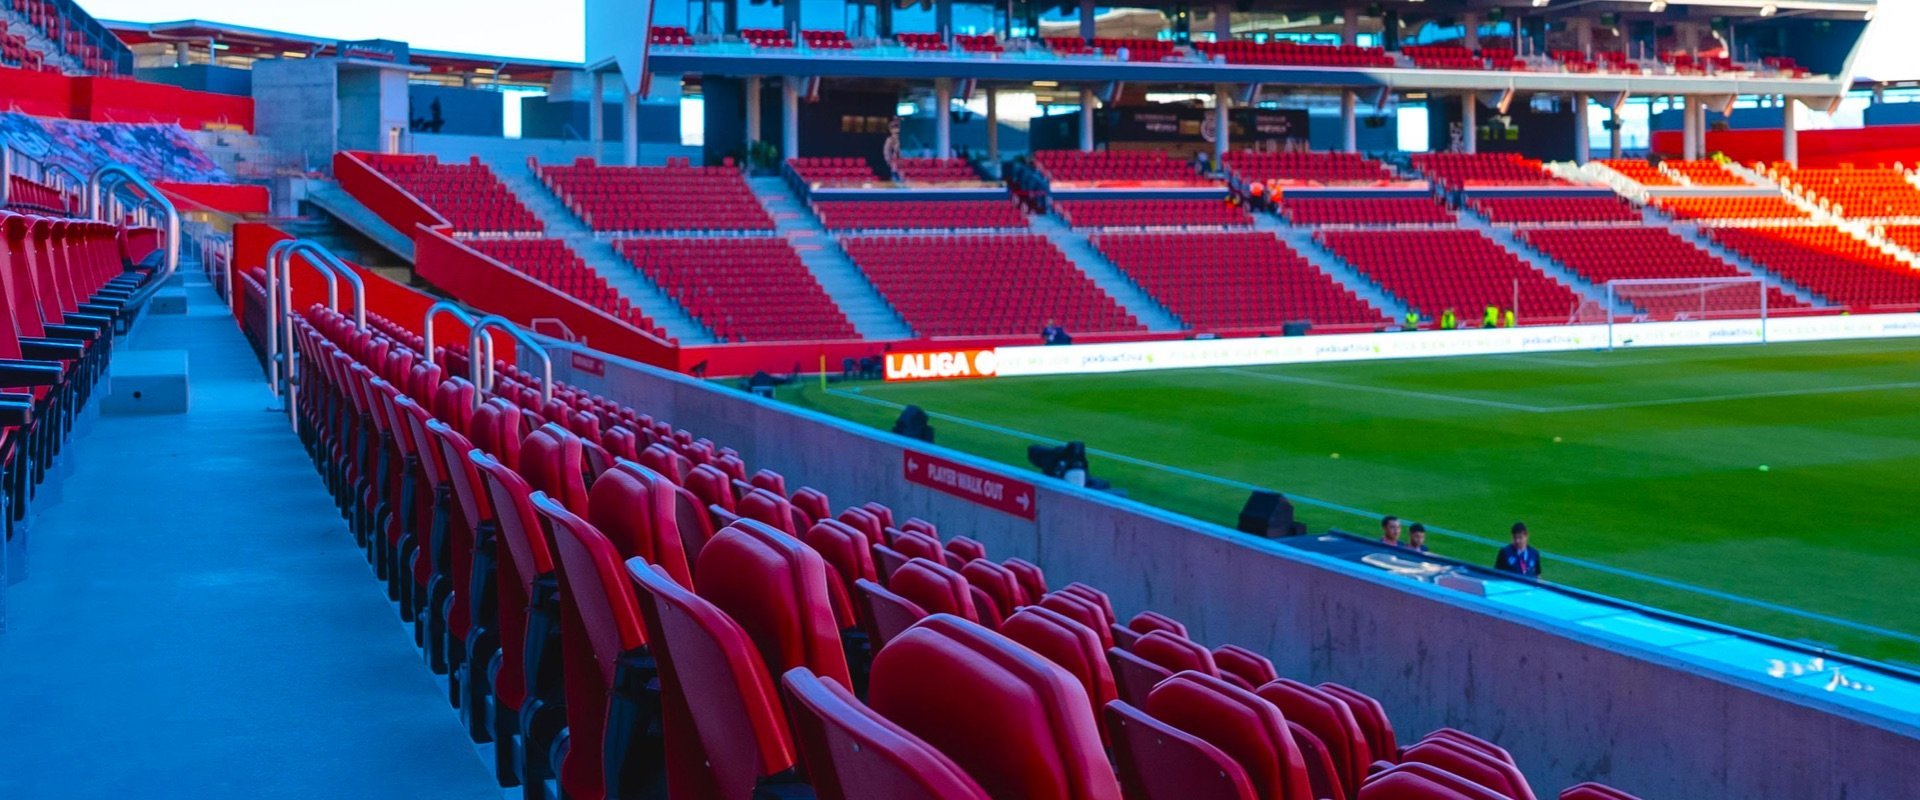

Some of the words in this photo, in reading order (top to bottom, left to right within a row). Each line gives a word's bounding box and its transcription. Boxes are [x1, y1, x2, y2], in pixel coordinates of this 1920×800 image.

[886, 351, 970, 379] LALIGA
[928, 463, 956, 486] PLAYER
[958, 473, 983, 494] WALK
[984, 480, 1003, 500] OUT
